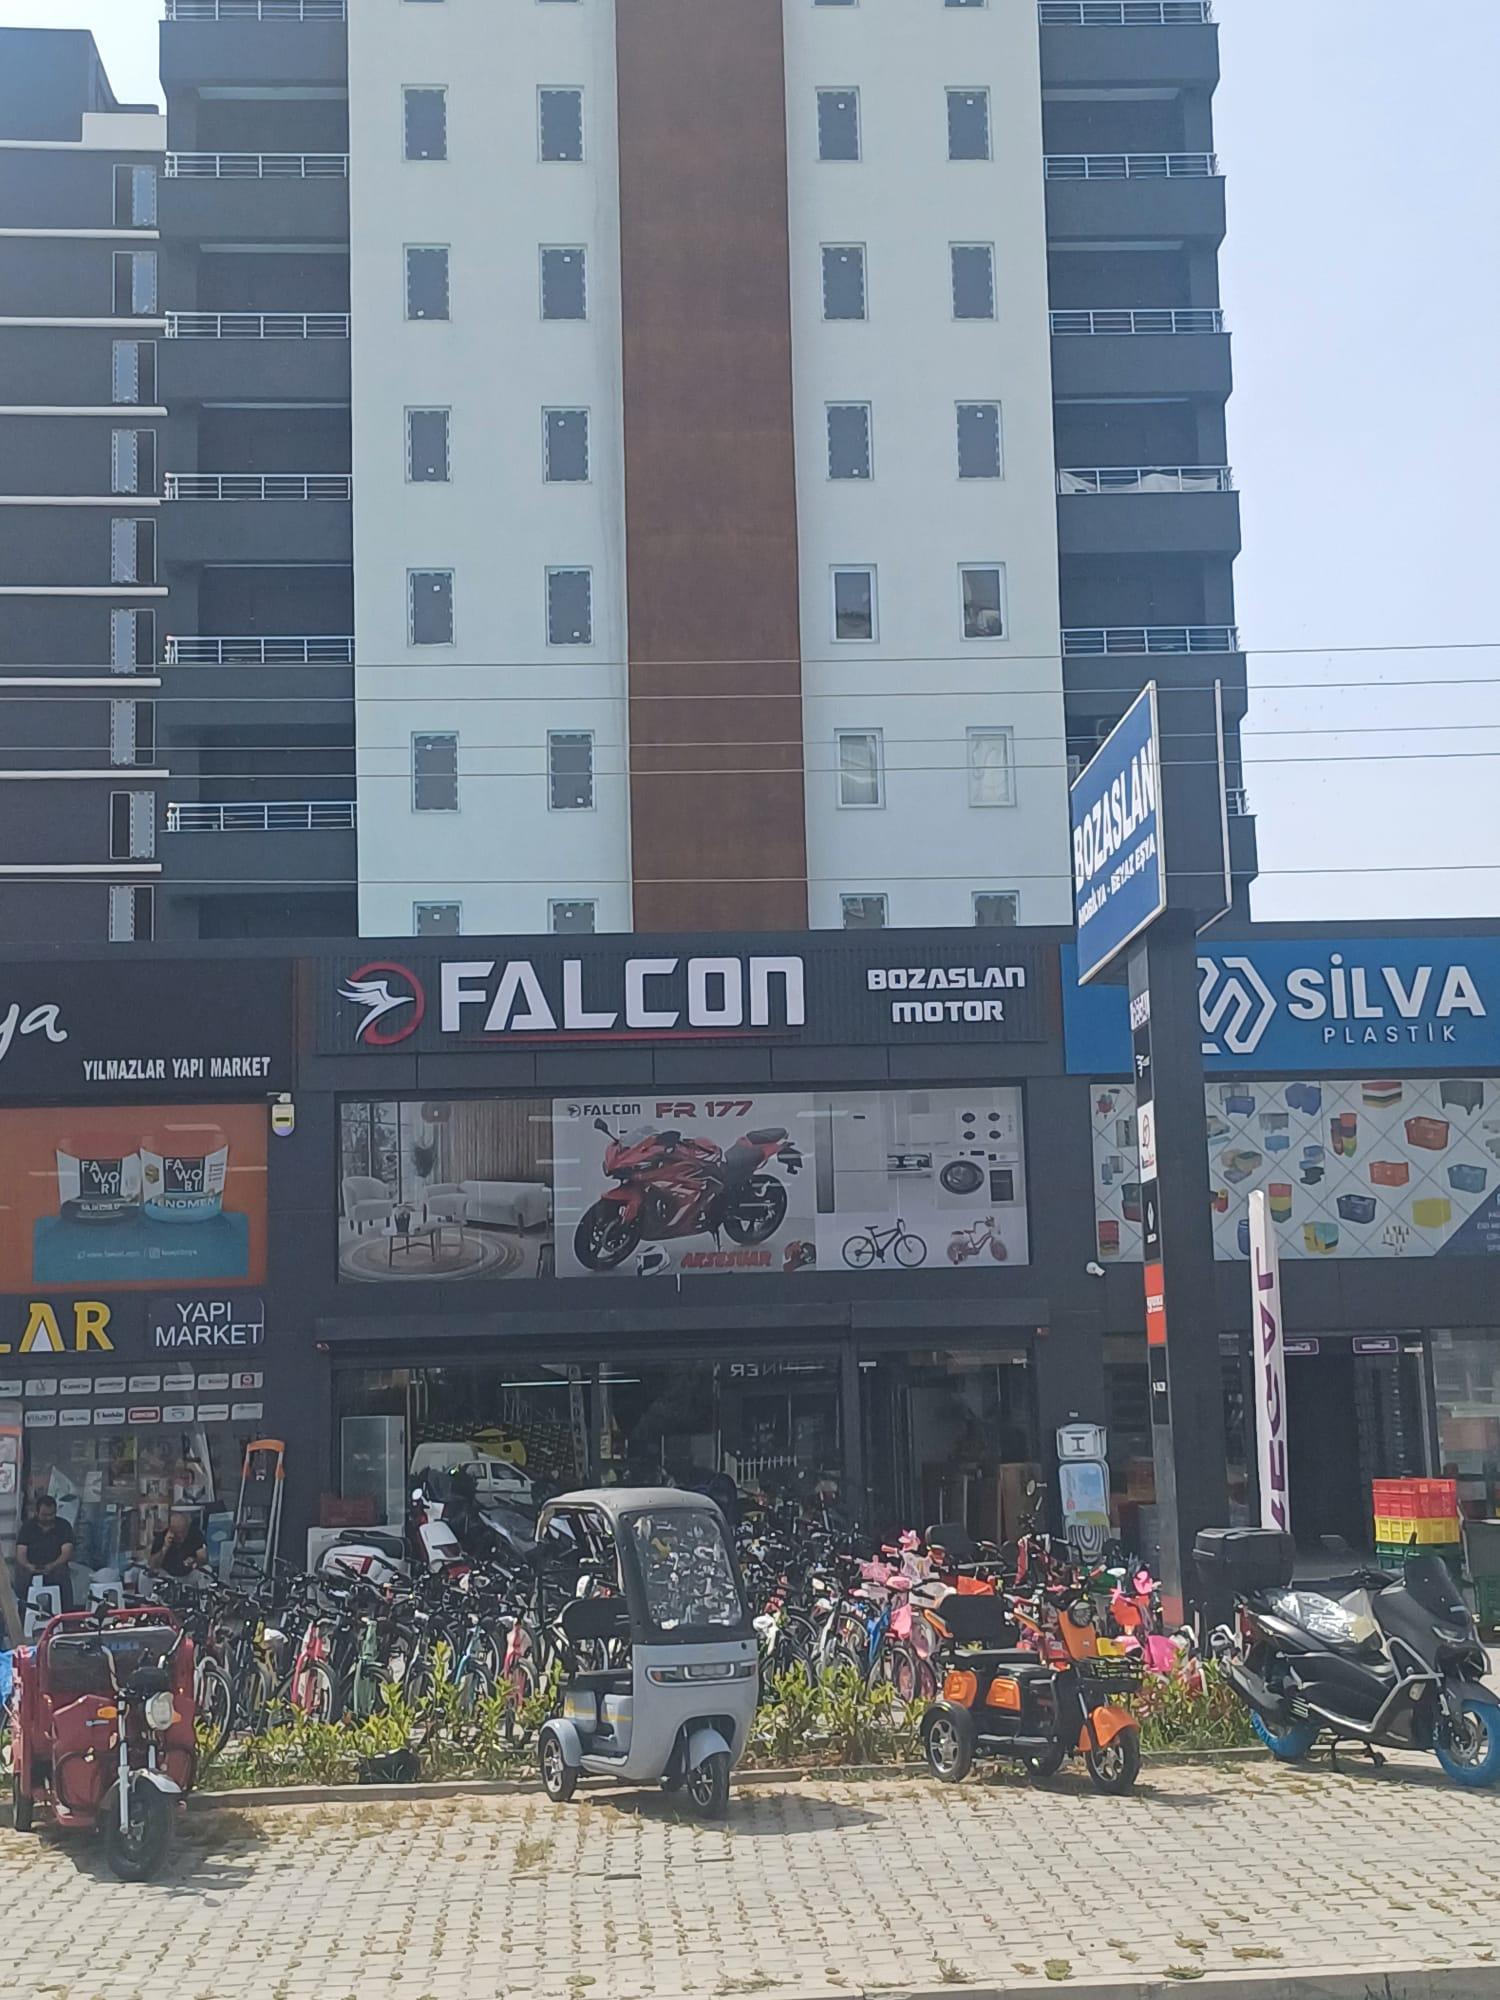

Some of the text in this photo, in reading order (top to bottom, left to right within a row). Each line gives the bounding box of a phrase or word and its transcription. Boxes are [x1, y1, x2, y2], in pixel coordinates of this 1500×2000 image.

[1073, 737, 1156, 893] BOZASLAN
[1135, 834, 1156, 873] EŞYA
[867, 966, 1026, 991] BOZASLAN
[1286, 953, 1487, 1020] SİLVA
[440, 956, 806, 1032] FALCON
[891, 999, 1005, 1023] MOTOR
[1323, 1021, 1457, 1044] PLASTİK
[83, 1056, 271, 1081] YILMAZLAR YAPI MARKET
[583, 1100, 754, 1119] FALCON FR 177
[177, 1301, 232, 1323] YAPI
[0, 1301, 115, 1352] AR
[155, 1324, 264, 1347] MARKET
